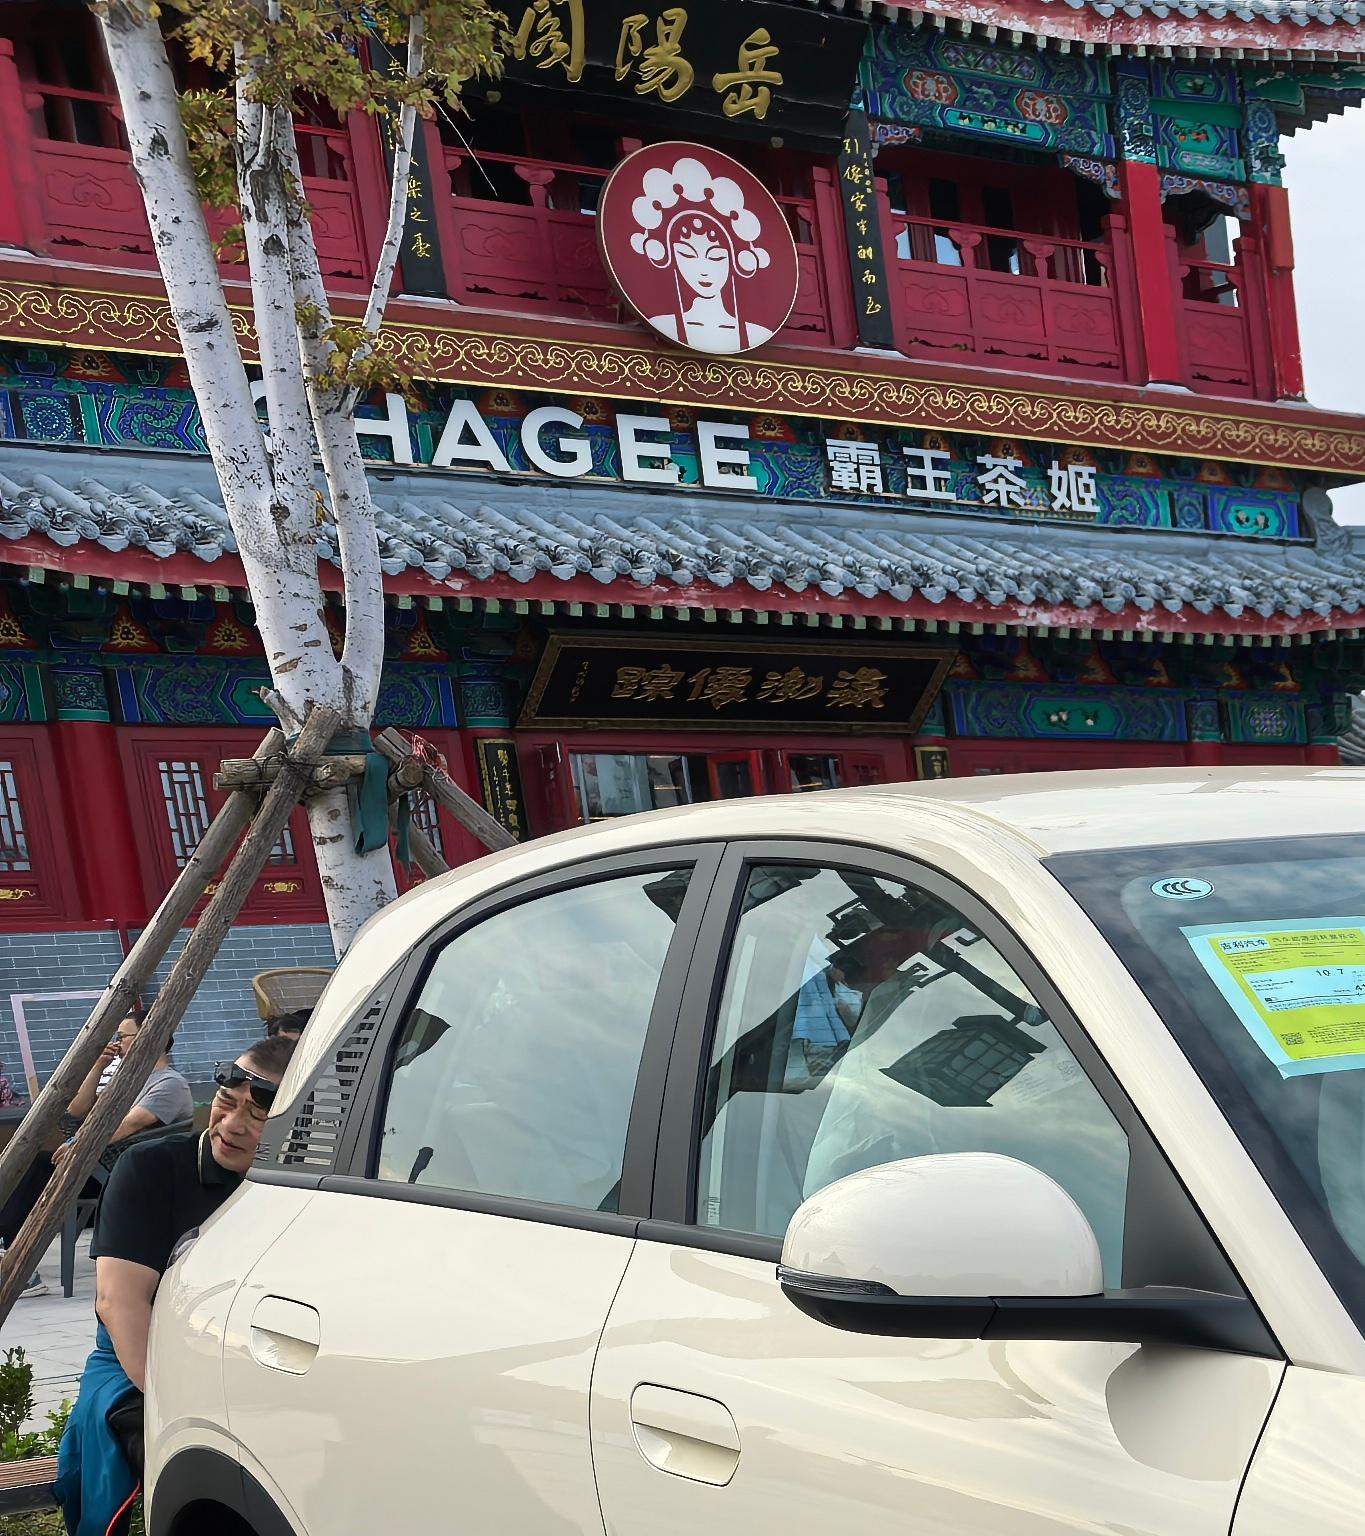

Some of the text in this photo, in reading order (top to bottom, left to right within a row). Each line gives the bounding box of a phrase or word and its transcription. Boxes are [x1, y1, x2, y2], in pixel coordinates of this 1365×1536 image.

[250, 379, 759, 491] HAGEE
[826, 438, 1101, 513] 霸王茶姬
